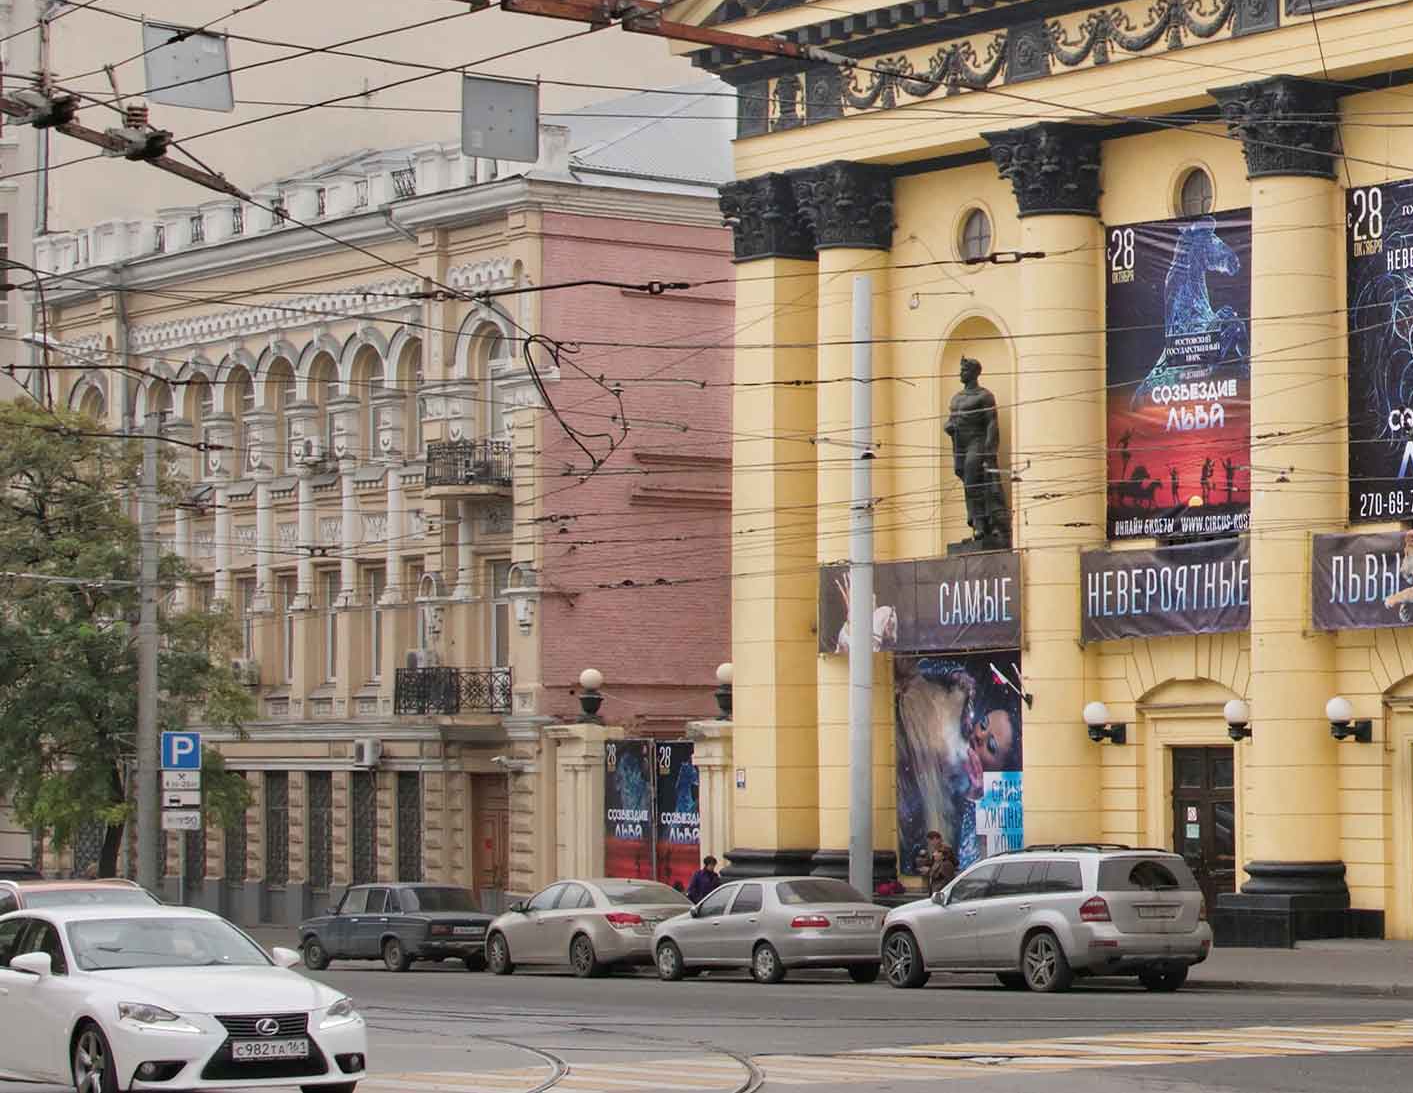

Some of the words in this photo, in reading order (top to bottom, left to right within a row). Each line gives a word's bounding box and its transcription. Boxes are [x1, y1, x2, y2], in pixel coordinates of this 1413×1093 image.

[1353, 187, 1382, 241] 28
[1111, 228, 1135, 271] 28
[1354, 239, 1383, 257] ОКТЯБРЯ
[1151, 380, 1237, 404] СОЗВЕЗДИЕ
[1166, 403, 1225, 432] ЛЬВА
[1088, 559, 1249, 618] НЕВЕРОЯТНЫЕ
[1329, 552, 1400, 603] ЛЬВЫ
[939, 578, 1013, 626] САМЫЕ
[172, 736, 194, 765] P
[607, 744, 617, 765] 28
[659, 746, 671, 768] 28
[608, 809, 648, 822] СОЗВЕЗДИЕ
[615, 824, 643, 839] ЛЬВА
